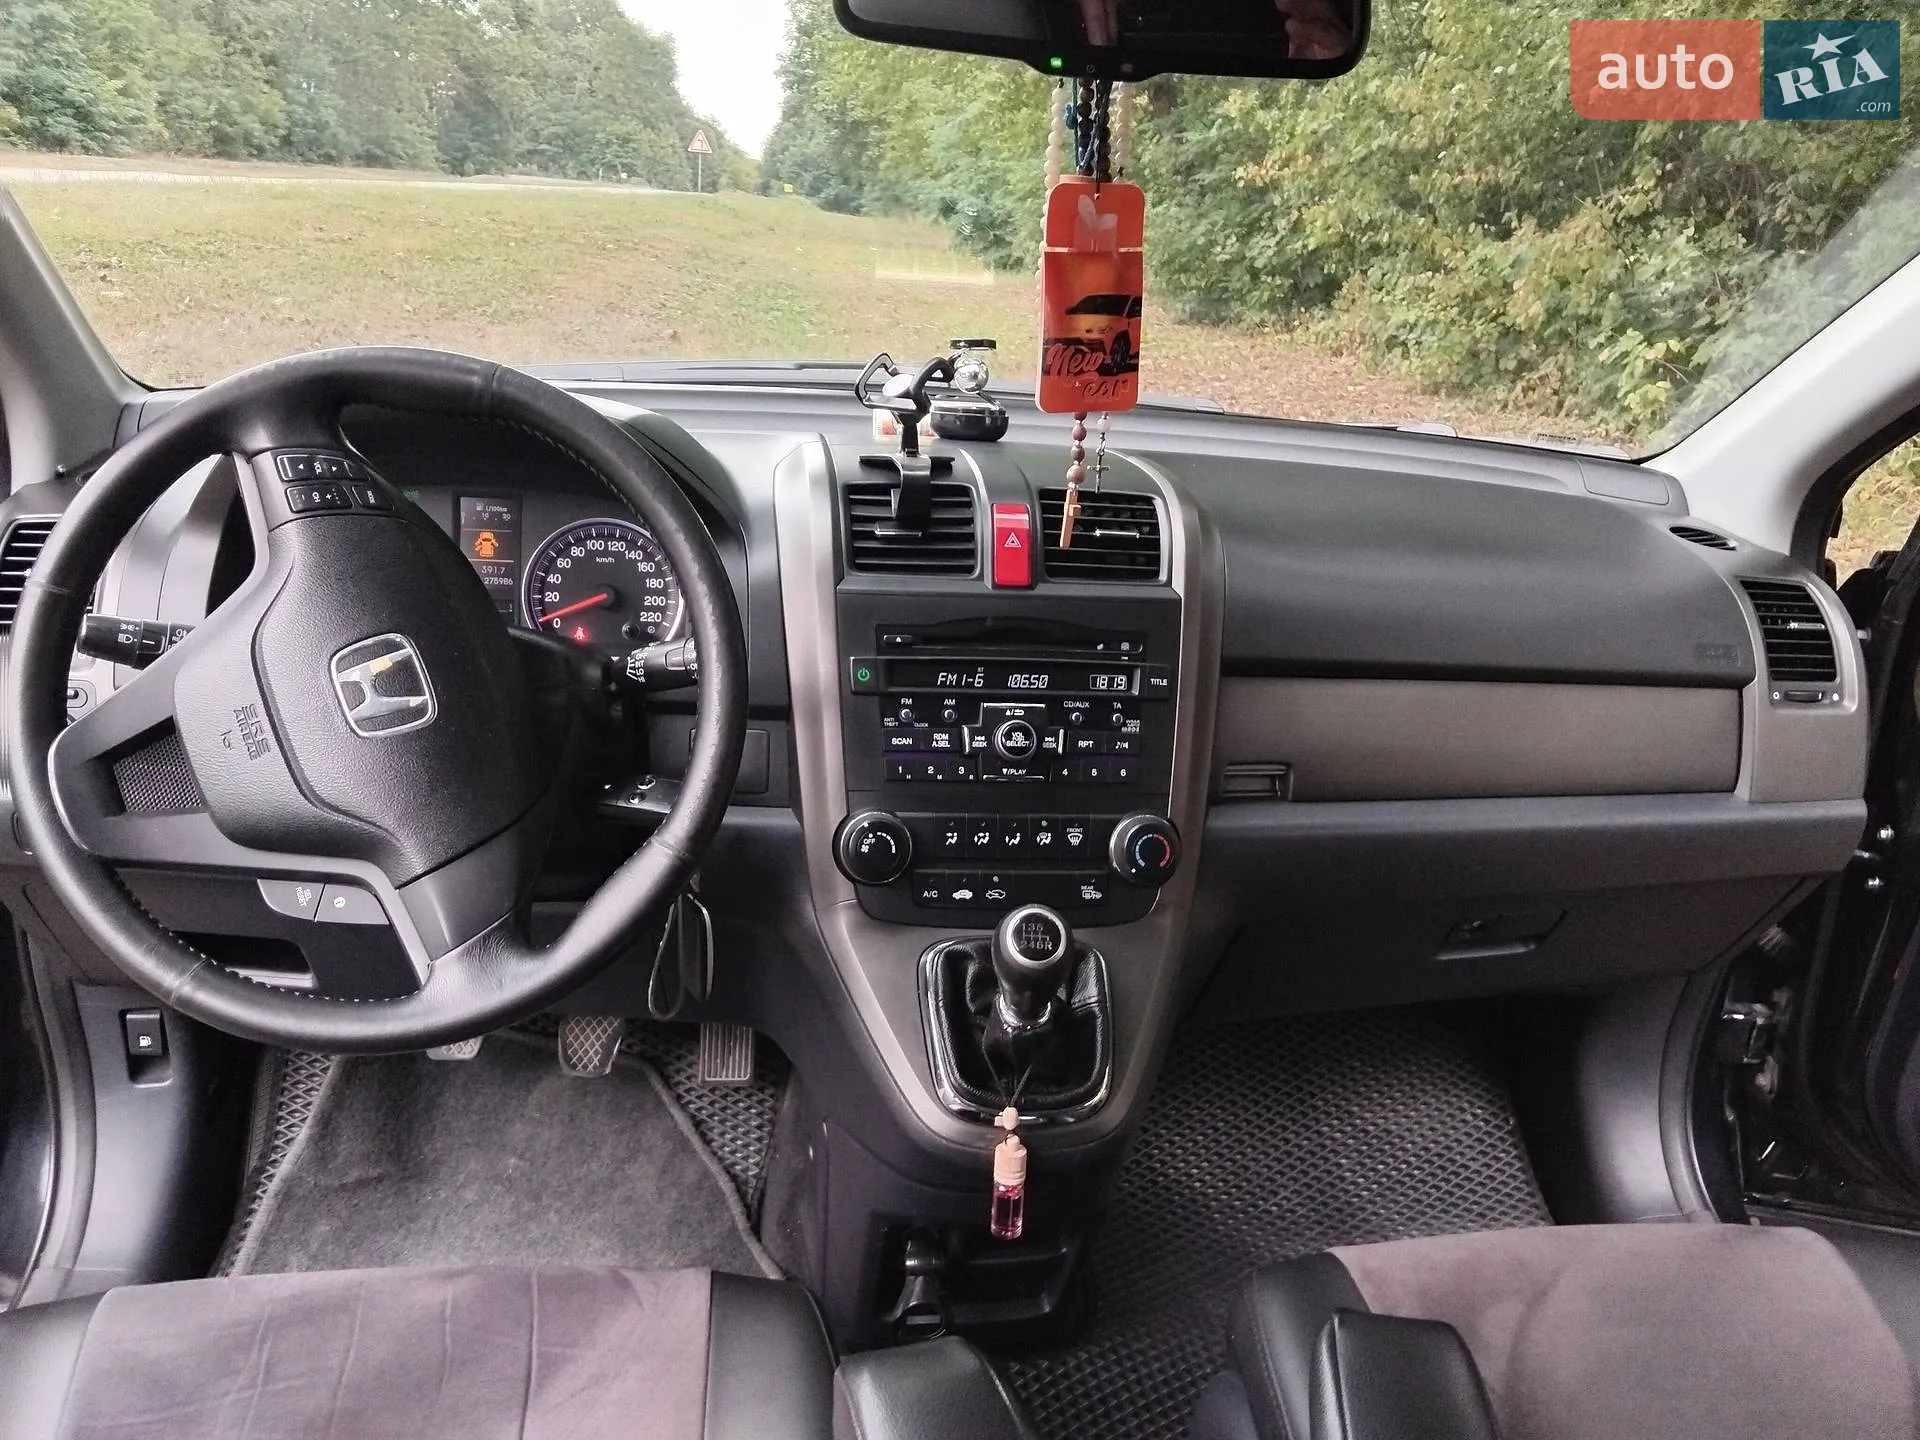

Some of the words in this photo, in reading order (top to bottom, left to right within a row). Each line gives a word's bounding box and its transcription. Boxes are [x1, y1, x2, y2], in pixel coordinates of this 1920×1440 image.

[1046, 343, 1105, 380] New
[586, 541, 605, 551] 100
[608, 541, 626, 551] 120
[571, 547, 585, 557] 80
[625, 550, 643, 560] 140
[557, 558, 571, 569] 60
[596, 556, 615, 564] km/h
[637, 562, 655, 573] 160
[547, 574, 562, 584] 40
[646, 578, 663, 589] 180
[545, 592, 560, 602] 20
[644, 596, 666, 606] 200
[640, 612, 662, 623] 220
[553, 618, 561, 628] 0
[1150, 678, 1168, 686] TITLE
[1063, 701, 1090, 709] CD/AUX
[1112, 702, 1122, 710] TA
[891, 737, 913, 745] SCAN
[1078, 740, 1094, 748] RPT
[927, 766, 934, 774] 2
[958, 766, 965, 774] 3
[1062, 768, 1068, 776] 4
[1091, 768, 1098, 777] 5
[1120, 768, 1127, 777] 6
[922, 890, 939, 898] A/C
